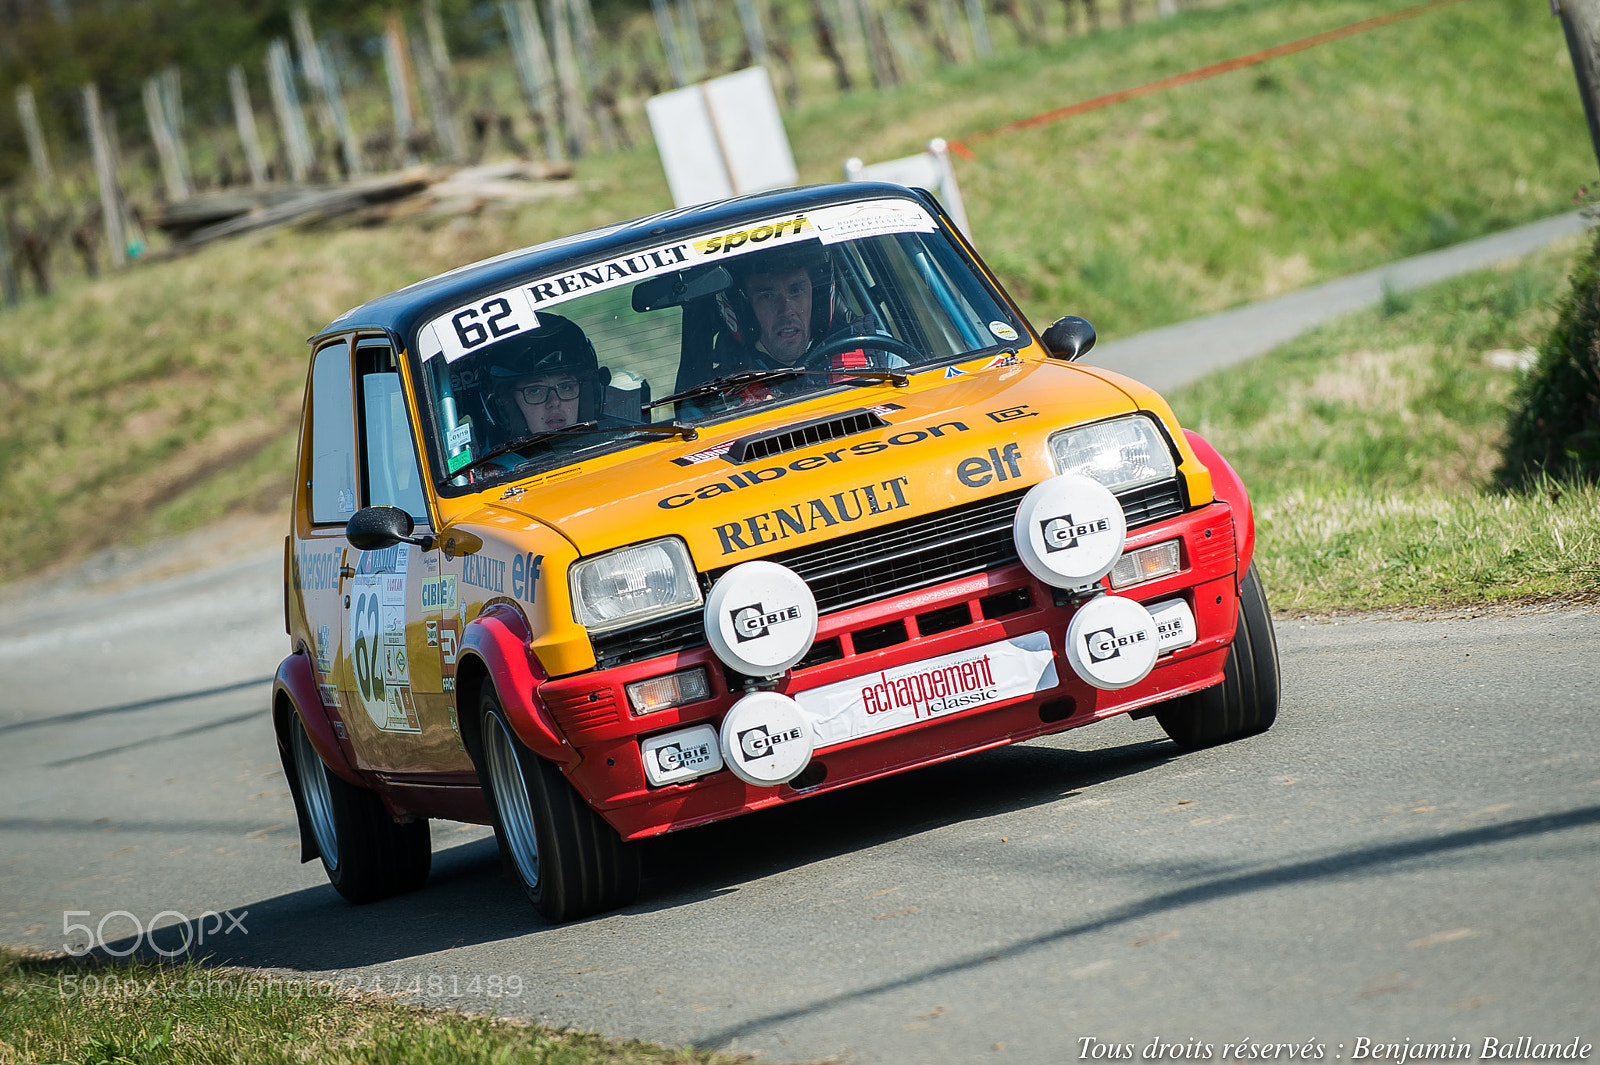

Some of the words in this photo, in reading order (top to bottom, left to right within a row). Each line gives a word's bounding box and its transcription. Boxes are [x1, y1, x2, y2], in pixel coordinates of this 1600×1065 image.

[452, 298, 520, 349] 62
[527, 245, 689, 303] RENAULT
[704, 215, 808, 254] sport
[657, 421, 969, 509] calberson
[713, 476, 911, 555] RENAULT
[957, 442, 1023, 488] elf
[462, 551, 505, 593] RENAULT
[512, 552, 544, 603] elf
[355, 593, 385, 702] 62
[861, 654, 995, 718] echappement
[931, 689, 999, 712] classic
